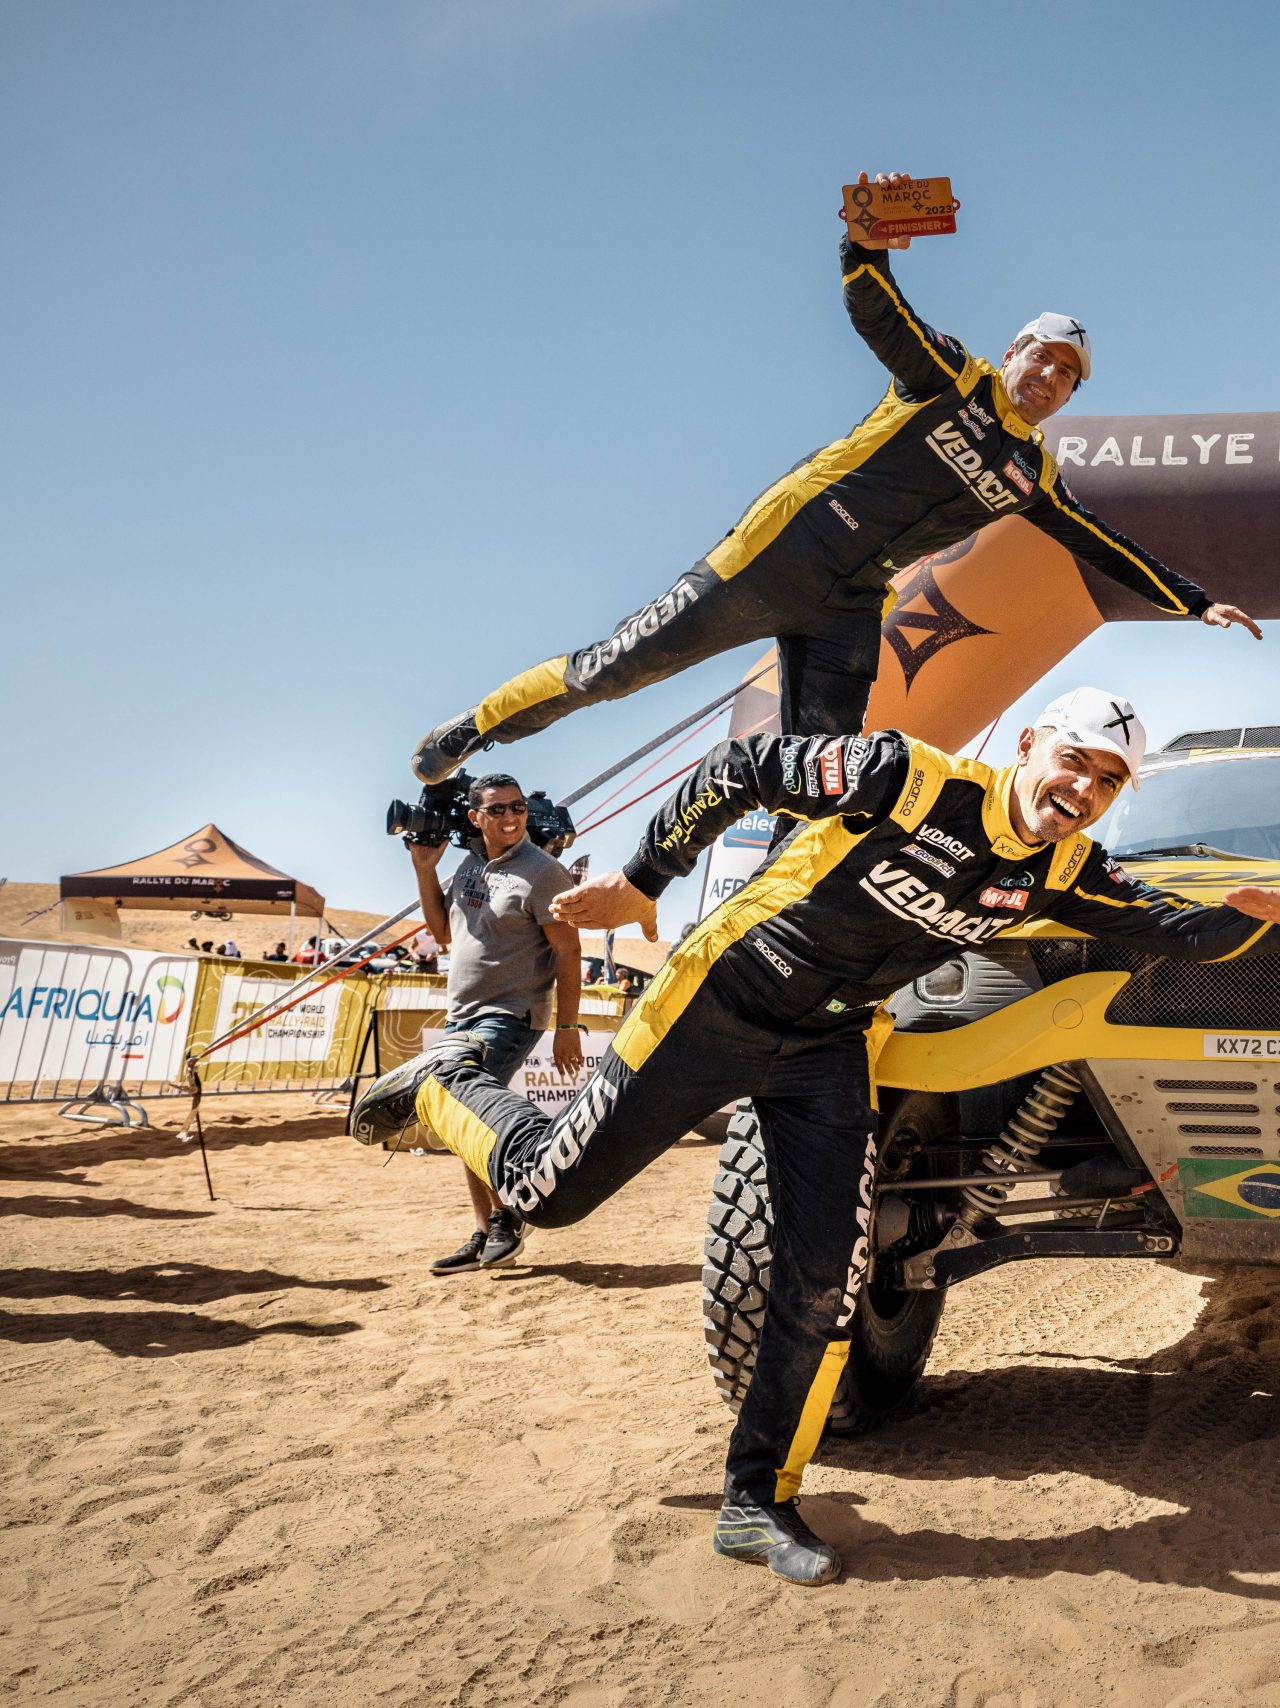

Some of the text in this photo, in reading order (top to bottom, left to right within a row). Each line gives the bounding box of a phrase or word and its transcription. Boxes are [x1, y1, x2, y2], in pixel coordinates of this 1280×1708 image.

[882, 189, 932, 204] MAROC
[917, 181, 929, 189] DU
[925, 205, 952, 215] 2023
[888, 221, 942, 234] FINISHER
[1056, 432, 1254, 466] RALLYE
[931, 420, 1020, 511] VEDACIT
[828, 499, 859, 531] sparco
[782, 740, 801, 790] dobens
[823, 743, 841, 791] OTUL
[846, 739, 868, 790] EDACIT
[902, 768, 926, 817] sparco
[1059, 843, 1086, 884] sparco
[133, 877, 230, 887] RALLYE DU MAROC
[868, 860, 1014, 945] VEDACIT
[754, 938, 793, 979] sparco
[0, 986, 153, 1024] AFRIQUIA
[300, 1004, 325, 1014] WORLD
[267, 1029, 325, 1038] CHAMPIONSHIP
[1217, 1038, 1263, 1056] KX72
[525, 1072, 594, 1087] RALLY-
[356, 1122, 369, 1144] OM
